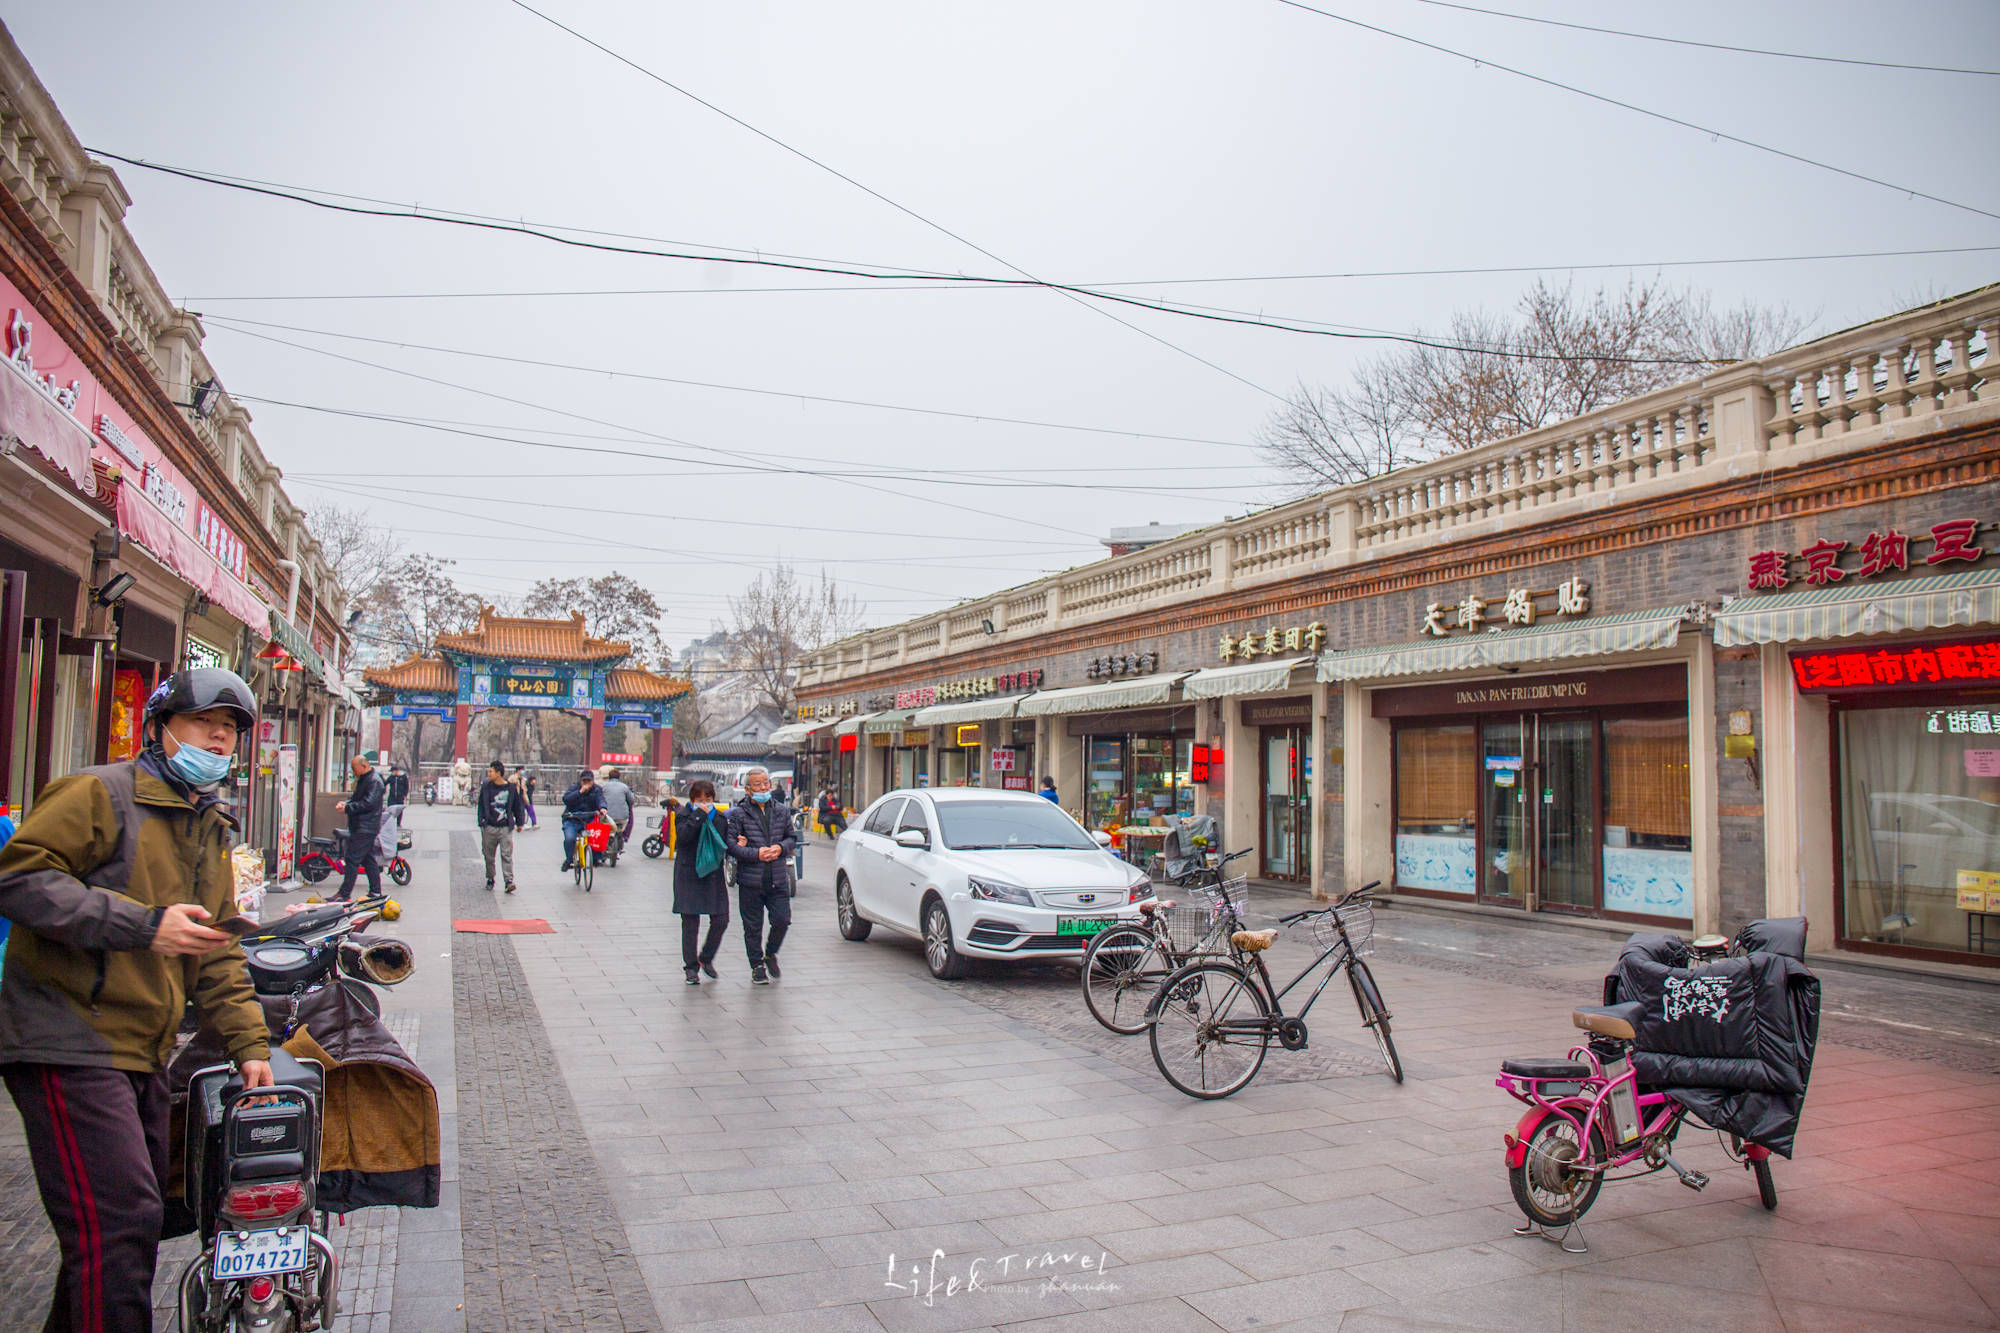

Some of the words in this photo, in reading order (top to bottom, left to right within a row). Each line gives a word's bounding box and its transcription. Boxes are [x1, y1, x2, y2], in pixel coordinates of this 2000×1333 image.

[1748, 519, 1982, 589] 燕京纳豆
[1420, 577, 1591, 636] 天津锅贴
[1219, 621, 1327, 663] 津味菜团子
[221, 1248, 302, 1273] 0074727
